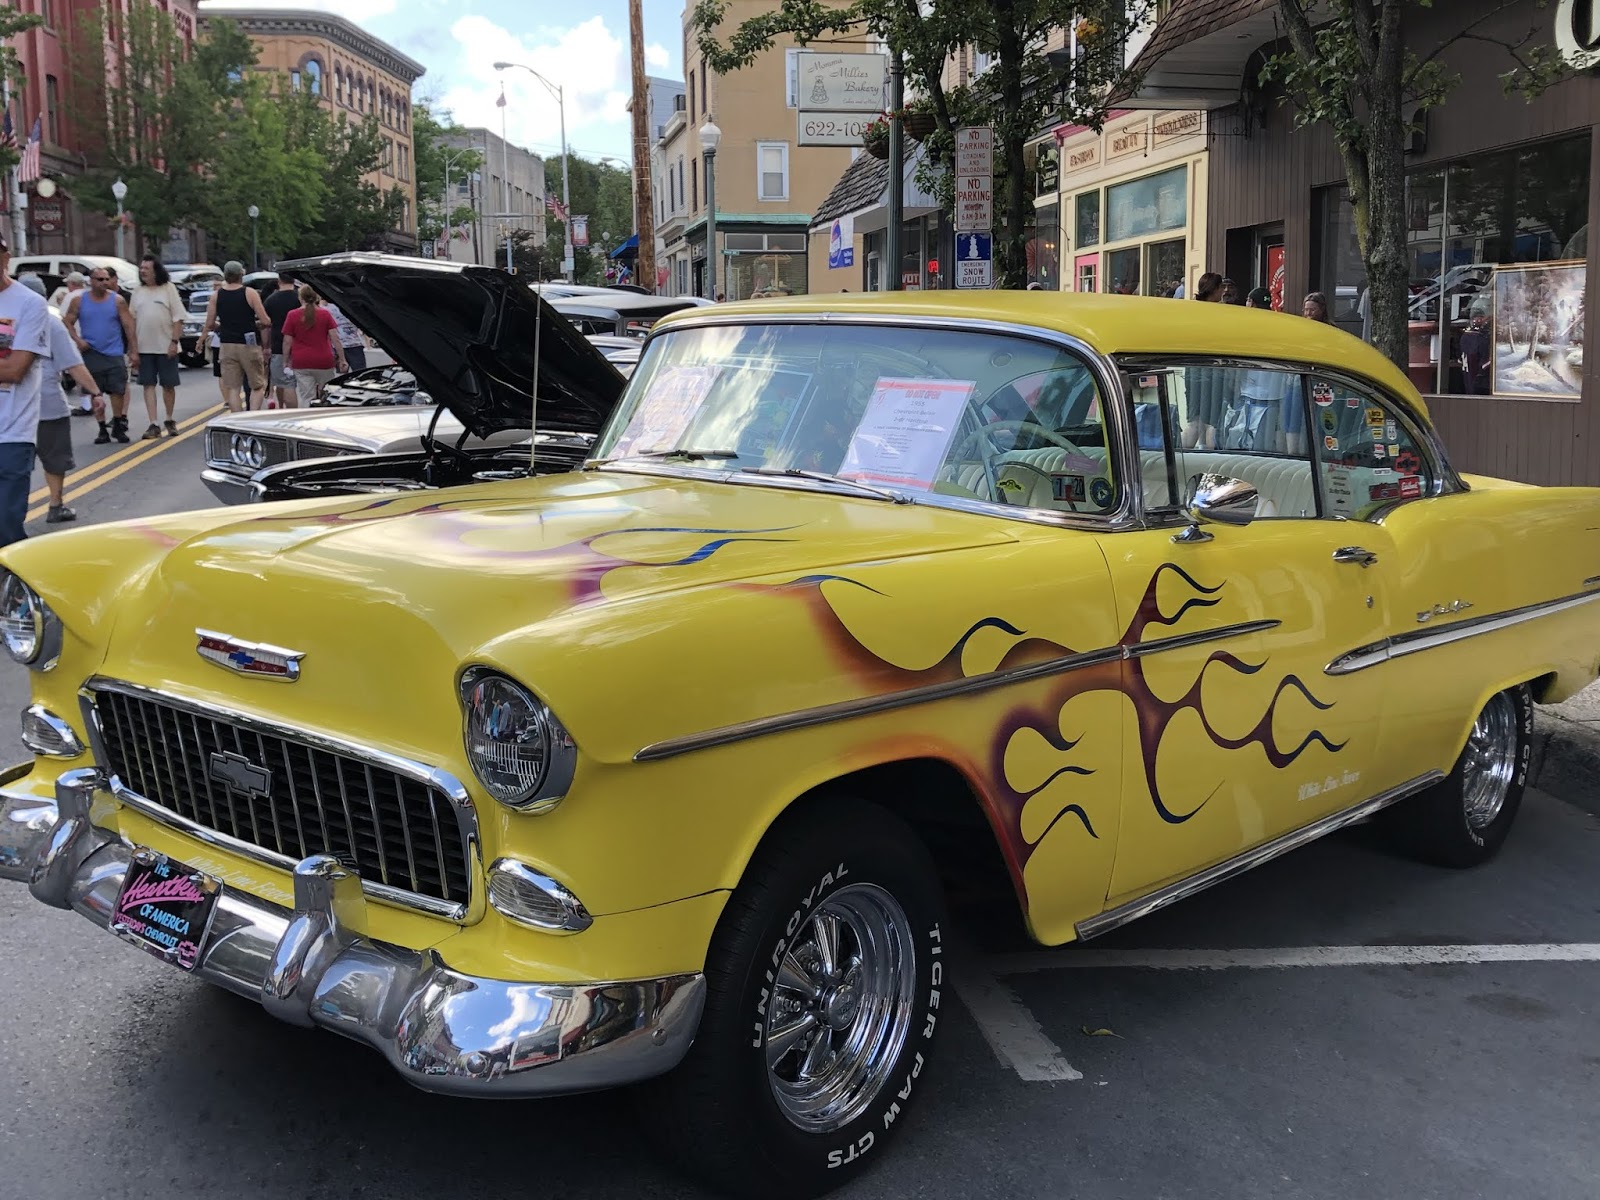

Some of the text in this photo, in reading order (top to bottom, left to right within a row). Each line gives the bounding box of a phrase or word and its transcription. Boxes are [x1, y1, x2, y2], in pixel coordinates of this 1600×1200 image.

[807, 59, 843, 73] Momma
[844, 81, 879, 96] Bakery
[968, 131, 980, 140] NO
[960, 142, 989, 150] PARKING
[967, 178, 981, 190] NO
[958, 190, 990, 202] PARKING
[901, 273, 920, 284] VOT
[962, 276, 985, 285] ROUTE
[153, 862, 170, 878] THE
[139, 903, 190, 935] OF AMERICA
[144, 926, 179, 948] CHEVROLET
[752, 862, 849, 1048] UNIROYAL
[923, 922, 943, 1039] TIGER
[883, 1051, 925, 1129] PAW
